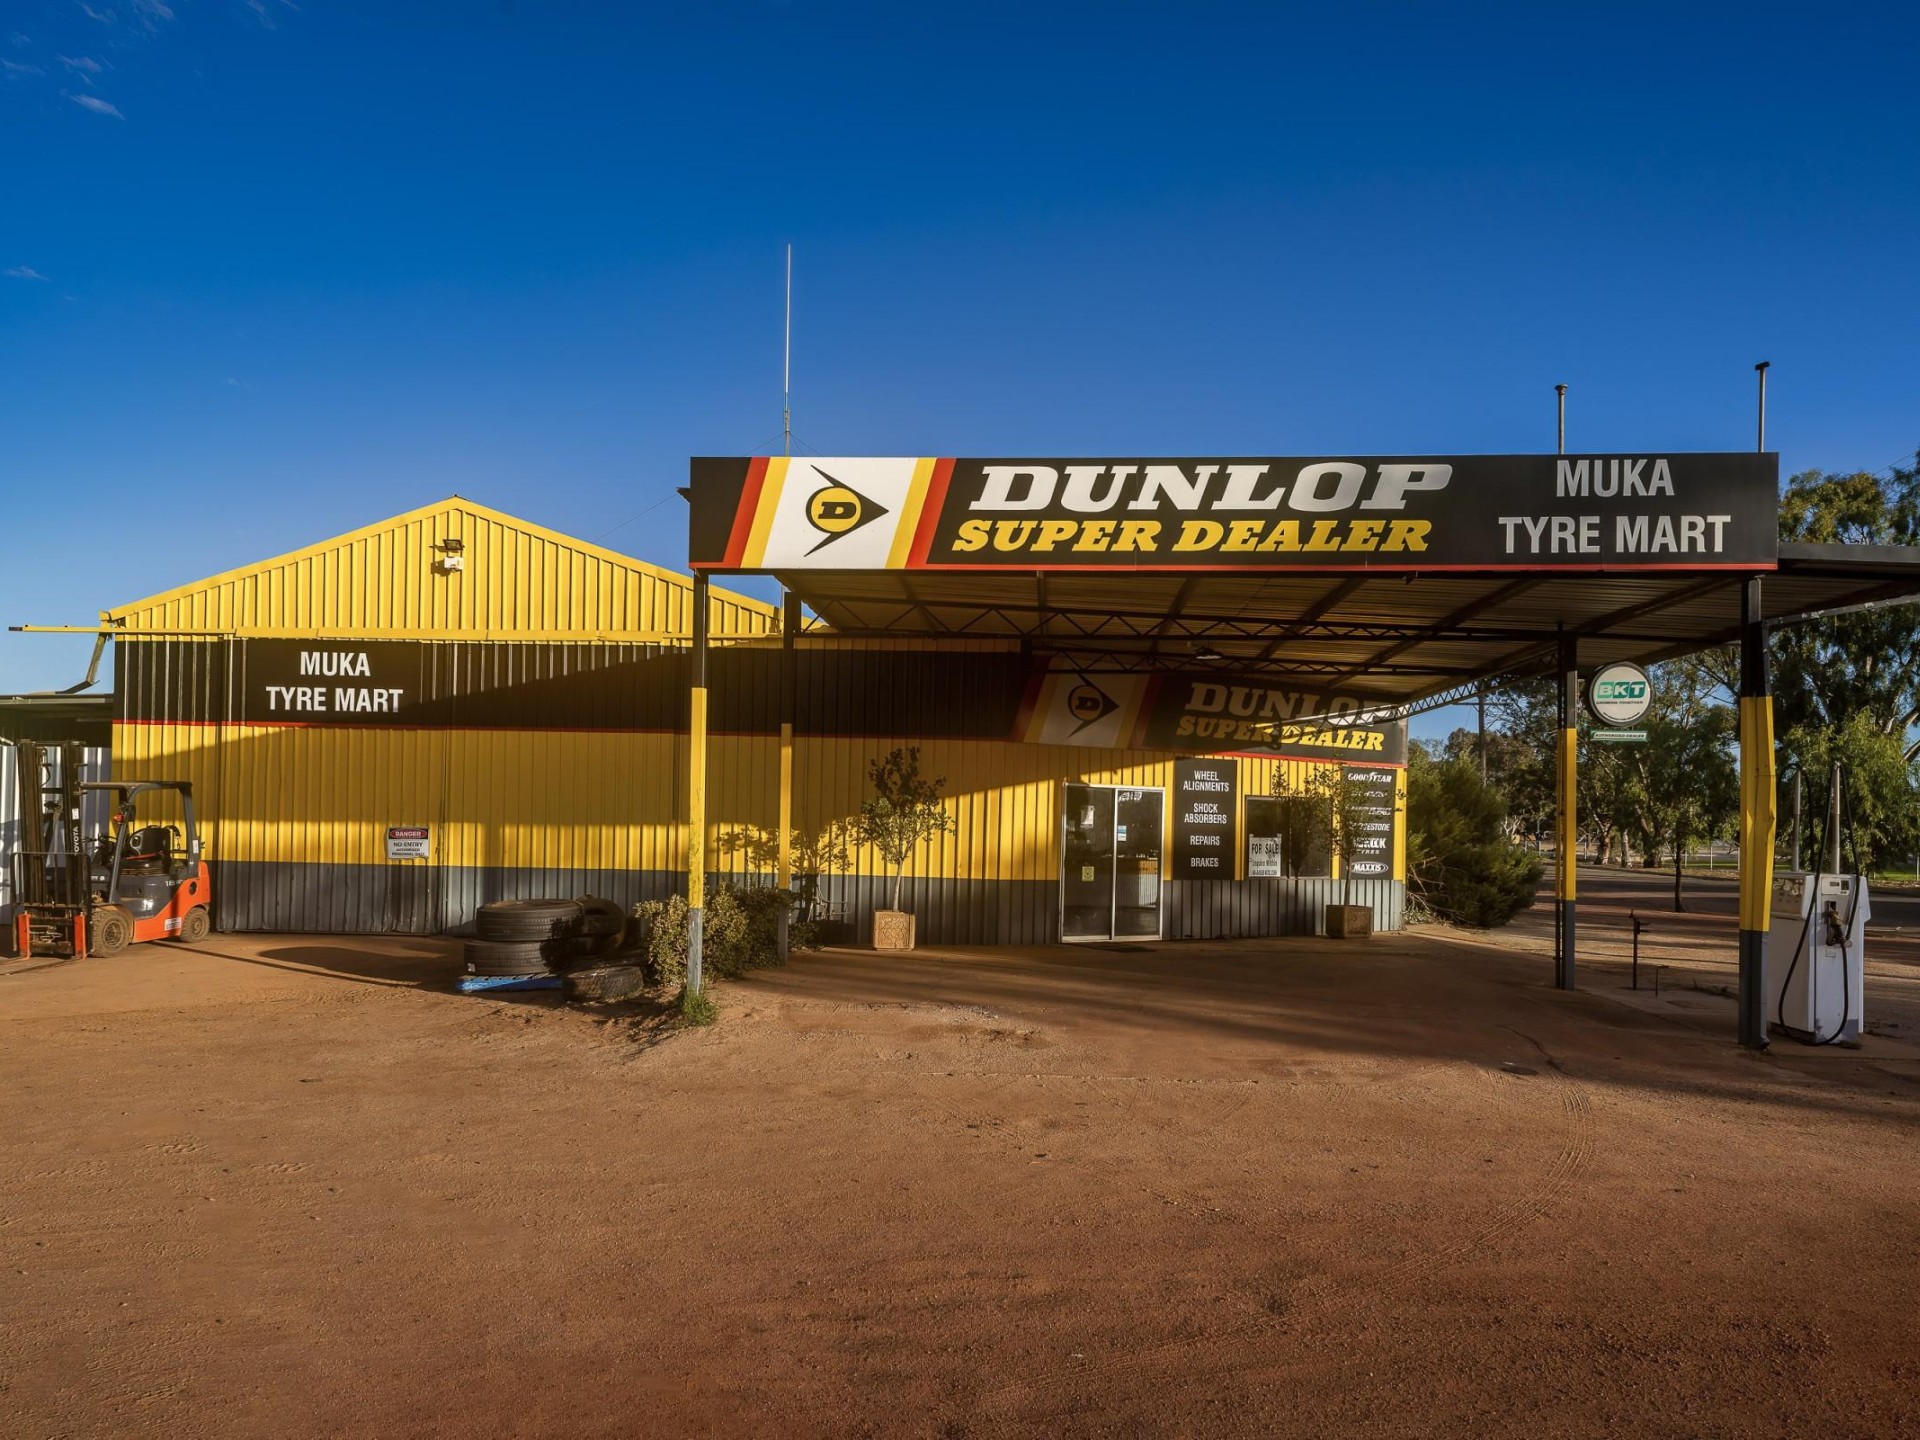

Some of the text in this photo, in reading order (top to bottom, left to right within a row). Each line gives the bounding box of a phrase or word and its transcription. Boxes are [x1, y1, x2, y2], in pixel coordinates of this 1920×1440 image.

[1556, 459, 1675, 497] MUKA
[968, 462, 1453, 512] DUNLOP
[818, 502, 857, 519] D
[951, 519, 1432, 551] SUPER DEALER
[1498, 515, 1732, 554] TYRE MART
[300, 651, 371, 677] MUKA
[1600, 684, 1645, 696] BKT
[265, 686, 404, 713] TYRE MART
[1279, 725, 1385, 751] DEALER
[1194, 770, 1219, 781] WHEEL
[1348, 772, 1392, 783] GOODYEAR
[1183, 780, 1230, 792] ALIGNMENTS
[1193, 803, 1218, 813] SHOCK
[1184, 813, 1227, 824] ABSORBERS
[1348, 822, 1391, 832] ESTONE
[1189, 836, 1220, 846] REPAIRS
[1251, 843, 1280, 855] FOR SALE
[1190, 858, 1219, 868] BRAKES
[1353, 863, 1382, 872] MAXXIS
